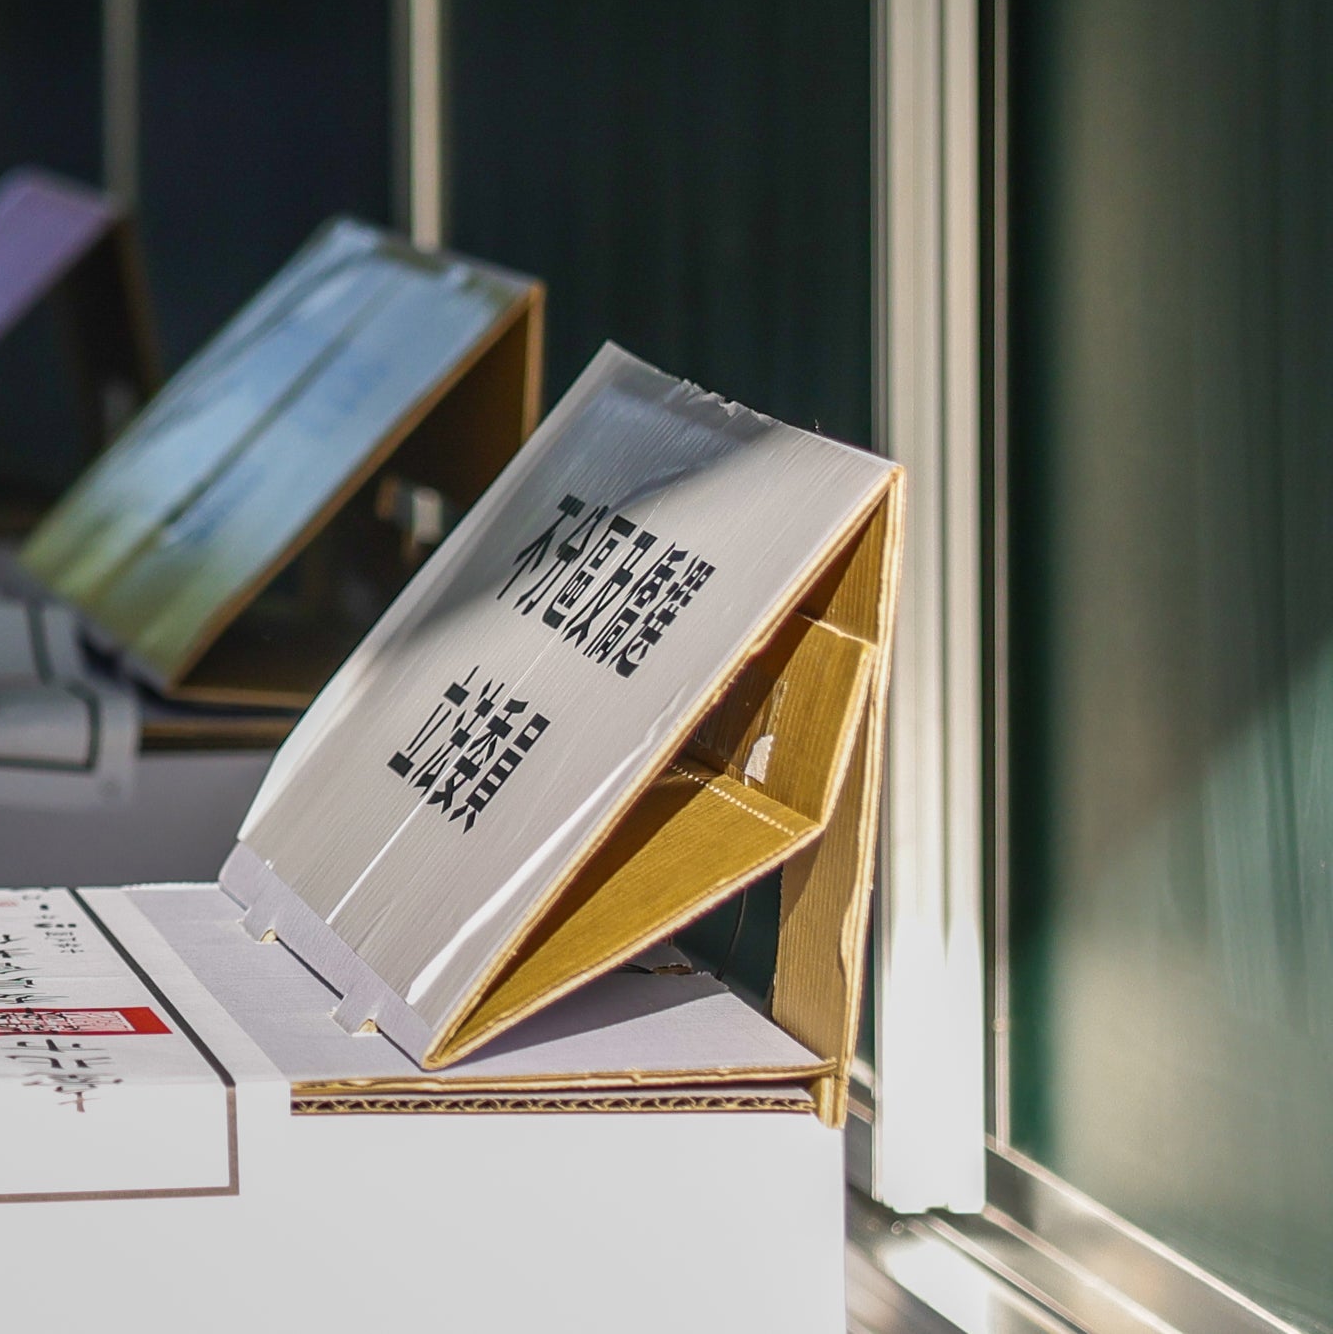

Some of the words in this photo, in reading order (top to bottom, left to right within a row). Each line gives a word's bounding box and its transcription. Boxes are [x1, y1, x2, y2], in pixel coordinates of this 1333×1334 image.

[497, 494, 714, 678] 不分區及僑選
[386, 666, 551, 834] 立法委員
